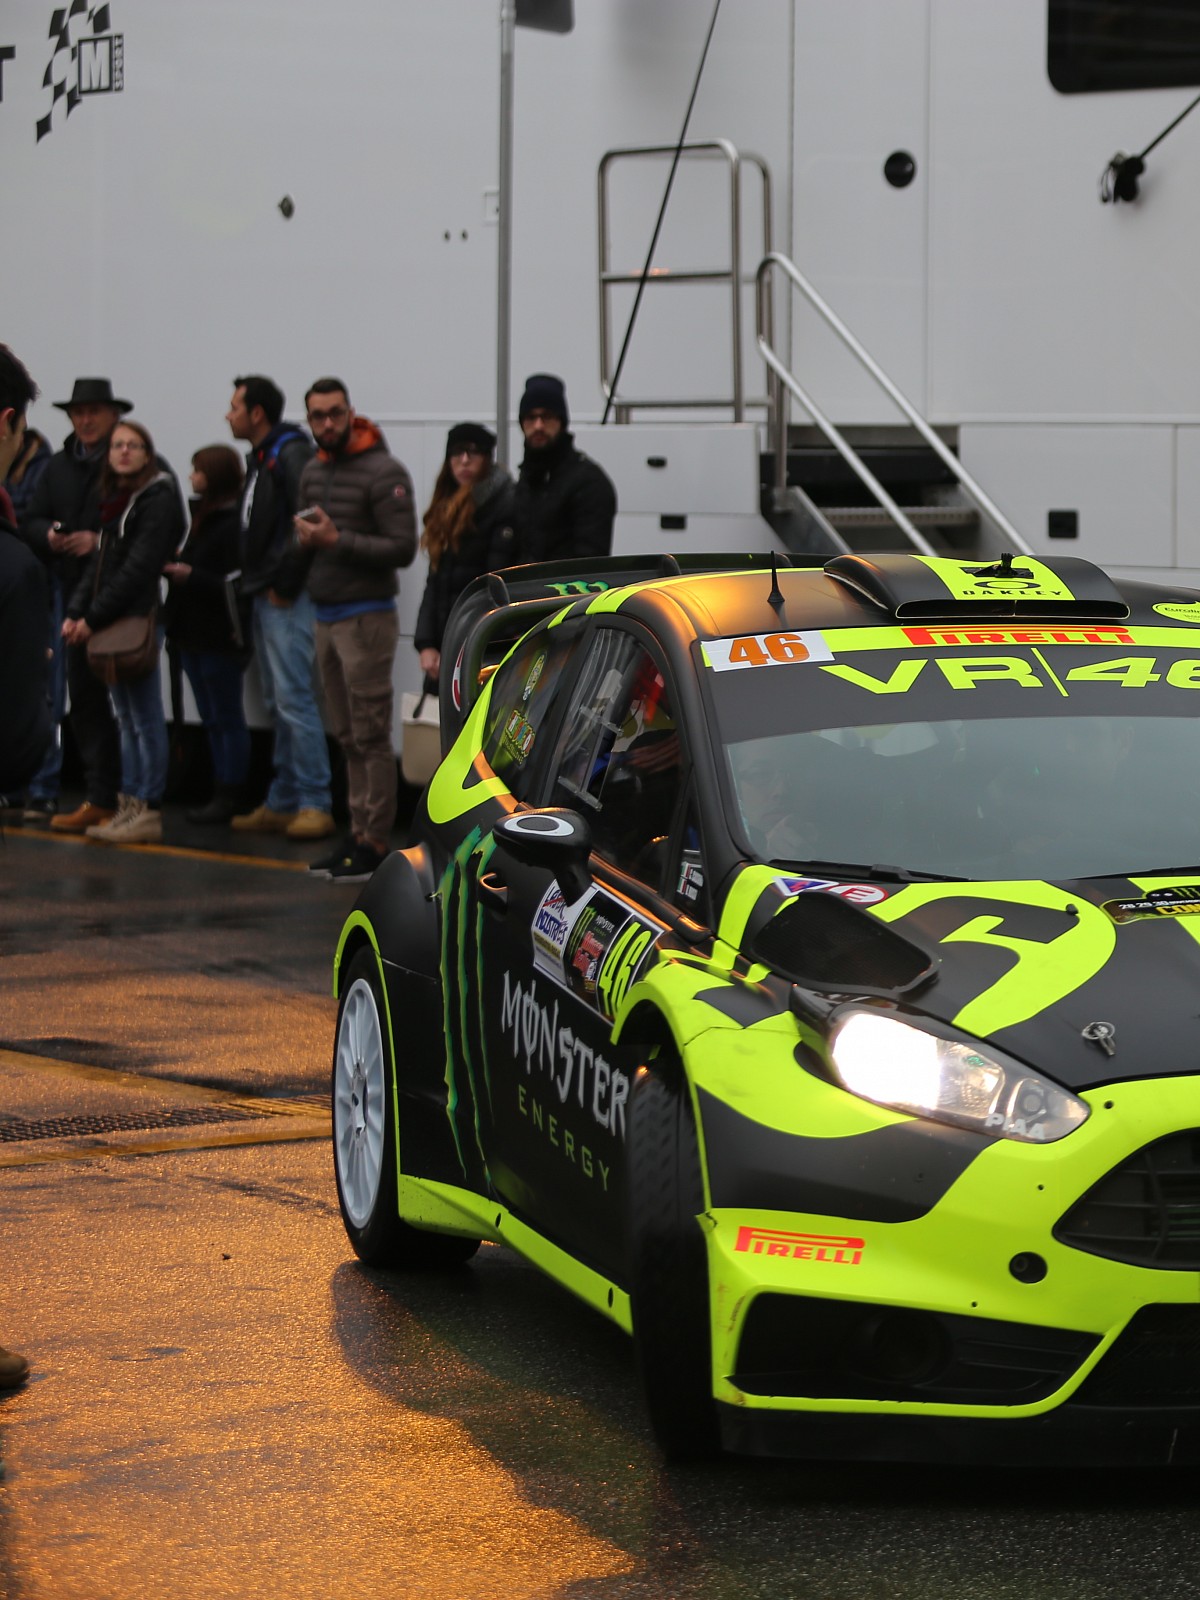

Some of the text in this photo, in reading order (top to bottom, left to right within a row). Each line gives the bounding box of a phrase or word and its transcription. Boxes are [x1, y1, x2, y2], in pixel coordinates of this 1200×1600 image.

[728, 633, 811, 666] 46
[901, 625, 1137, 646] PIRELLI
[599, 921, 652, 1017] 46
[502, 970, 629, 1144] MONSTER
[518, 1084, 610, 1192] ENERGY
[985, 1113, 1045, 1140] PIAA
[734, 1225, 866, 1265] PIRELLI
